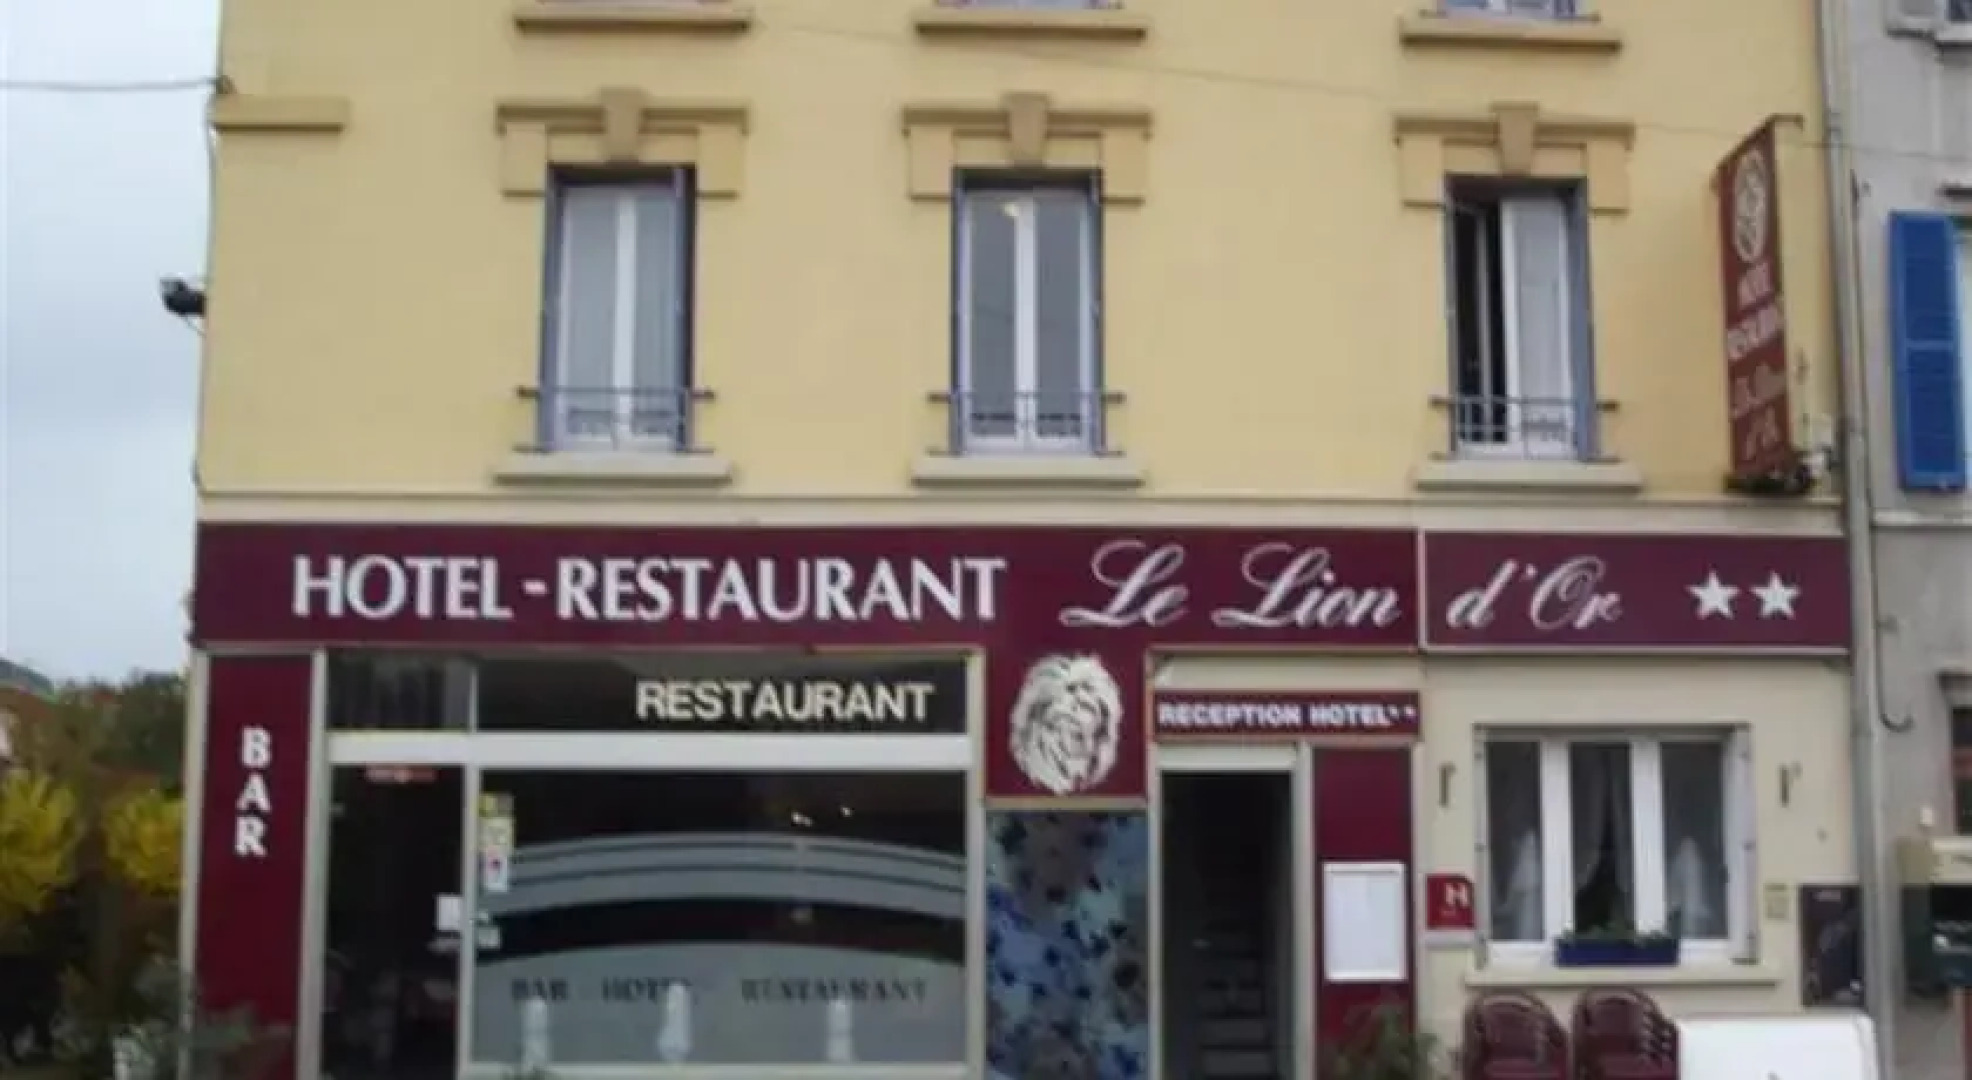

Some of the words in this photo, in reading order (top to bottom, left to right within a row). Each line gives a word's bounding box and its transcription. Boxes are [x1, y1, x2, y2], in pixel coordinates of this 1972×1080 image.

[1058, 539, 1189, 628] Le
[1210, 542, 1401, 628] Lion
[636, 679, 936, 722] RESTAURANT
[1158, 701, 1301, 727] RECEPTION
[235, 727, 271, 858] BAR
